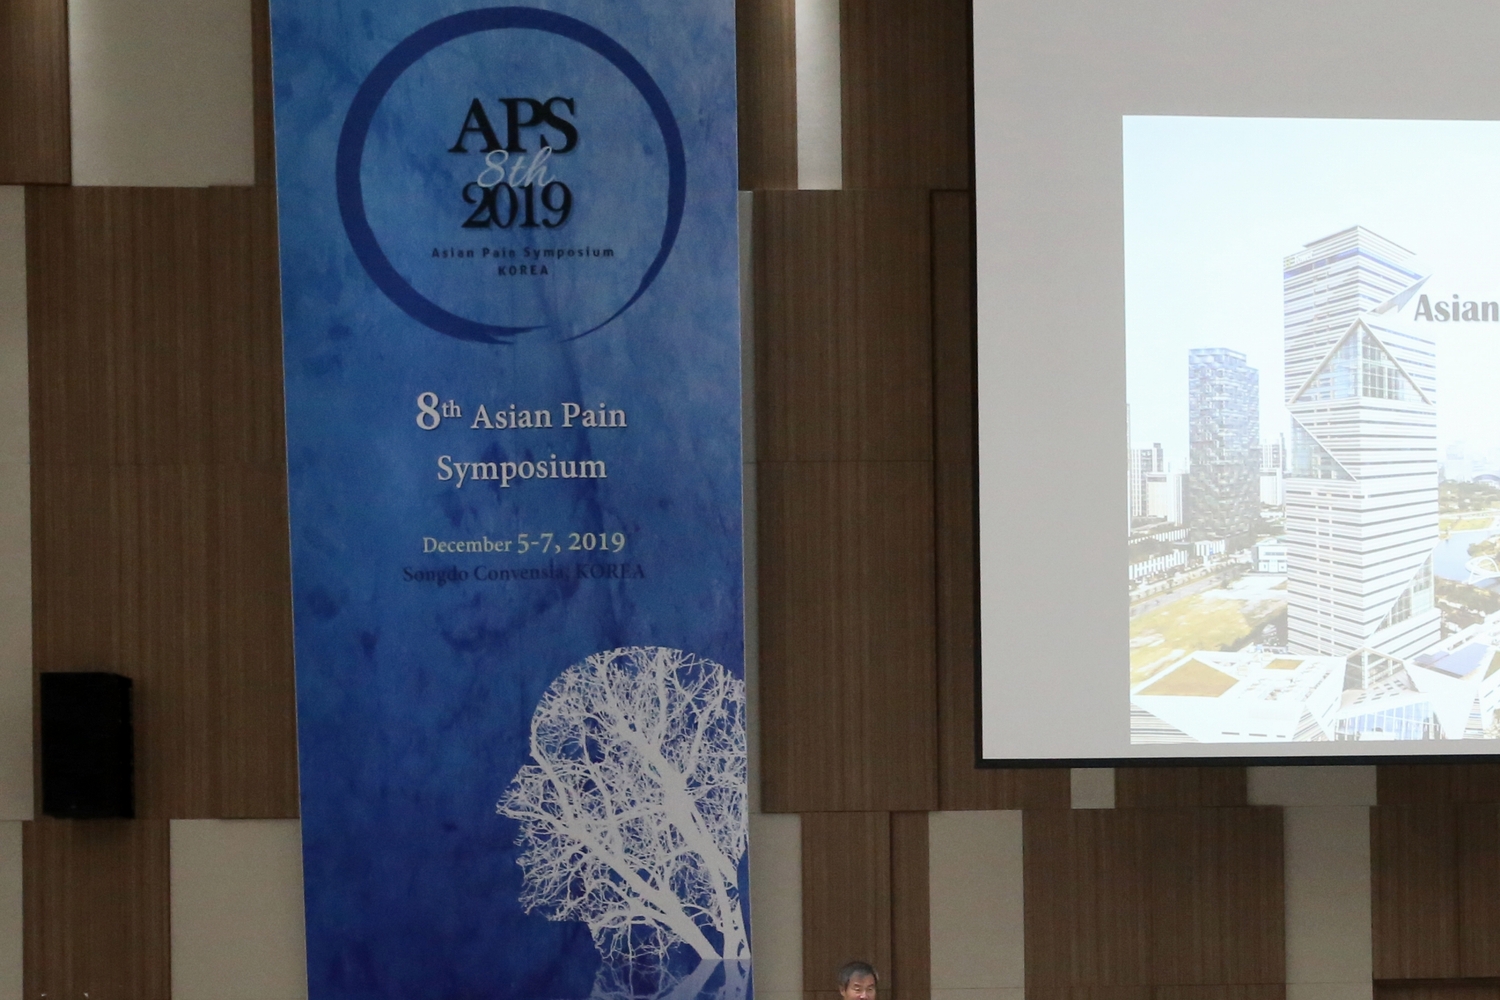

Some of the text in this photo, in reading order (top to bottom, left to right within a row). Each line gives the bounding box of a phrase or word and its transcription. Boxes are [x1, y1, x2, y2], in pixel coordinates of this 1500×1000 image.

[448, 97, 578, 154] APS
[477, 146, 556, 188] 8th
[461, 181, 573, 229] 2019
[431, 246, 615, 260] Asian Pain Symposium
[498, 265, 549, 276] KOREA
[1413, 294, 1500, 324] Asian
[416, 391, 628, 430] 8th Asian Pain
[437, 454, 608, 488] Symposium
[423, 532, 626, 554] December 5-7, 2019
[402, 561, 646, 588] Songdo Convensia, KOREA
